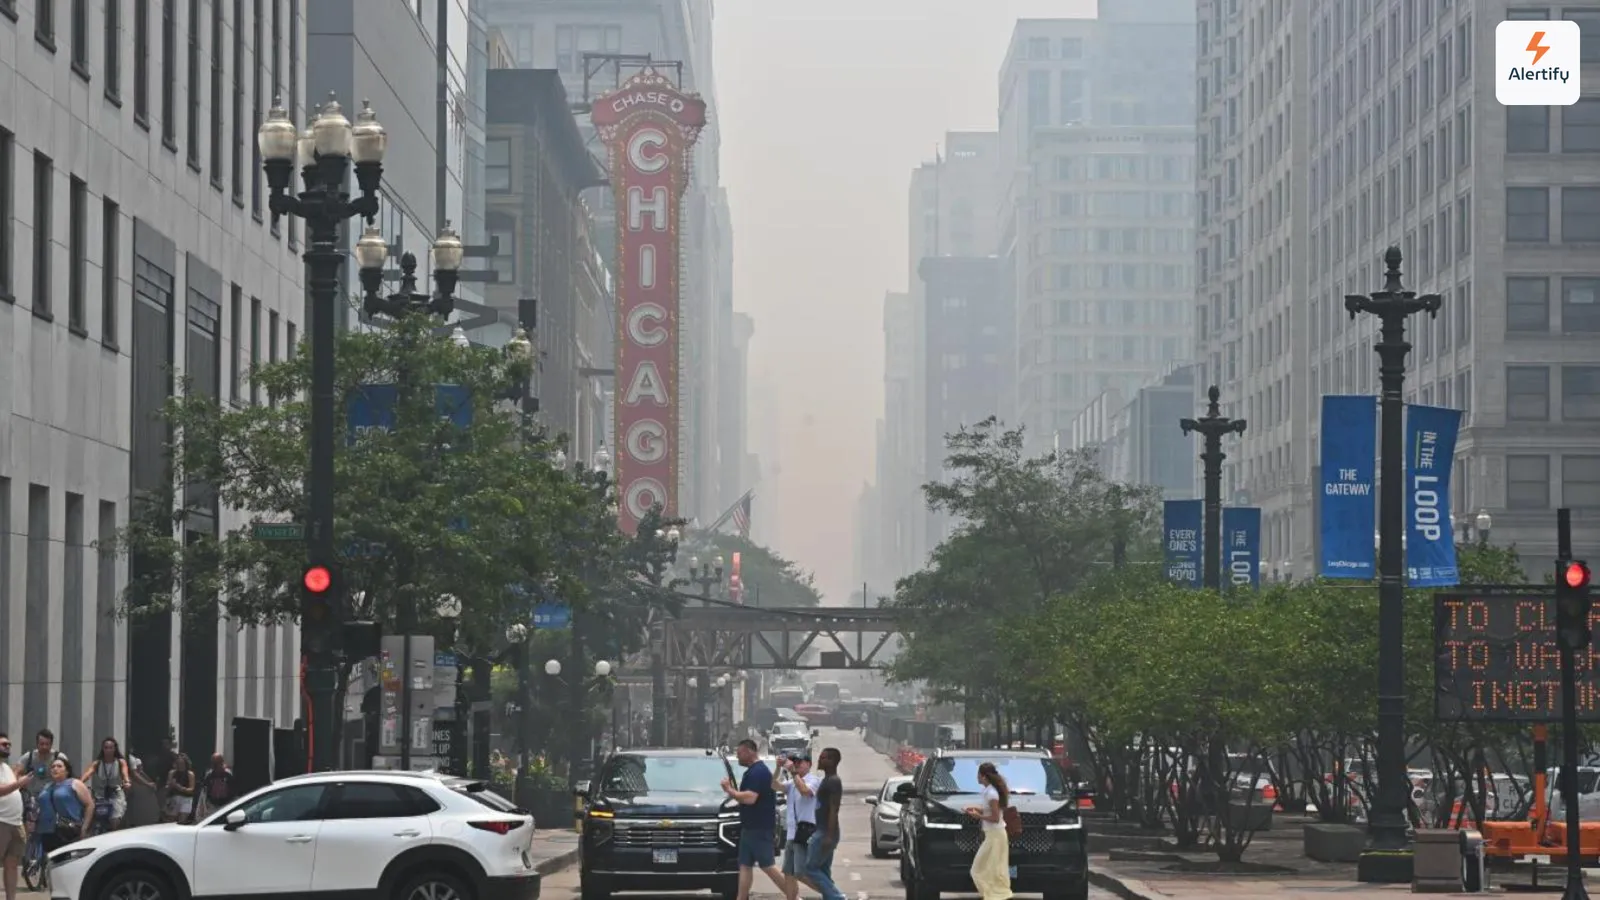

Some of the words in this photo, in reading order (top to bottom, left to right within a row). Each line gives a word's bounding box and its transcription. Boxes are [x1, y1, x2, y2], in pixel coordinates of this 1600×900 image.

[612, 92, 669, 113] CHASE
[625, 128, 669, 523] CHICAGO
[1422, 431, 1437, 445] IN
[1420, 446, 1436, 469] THE
[1339, 469, 1358, 481] THE
[1325, 483, 1371, 496] GATEWAY
[1414, 475, 1441, 541] LOOP
[1169, 529, 1197, 539] EVERY
[1169, 540, 1197, 551] ONE'S
[1443, 601, 1488, 631] TO
[1444, 640, 1489, 670] TO
